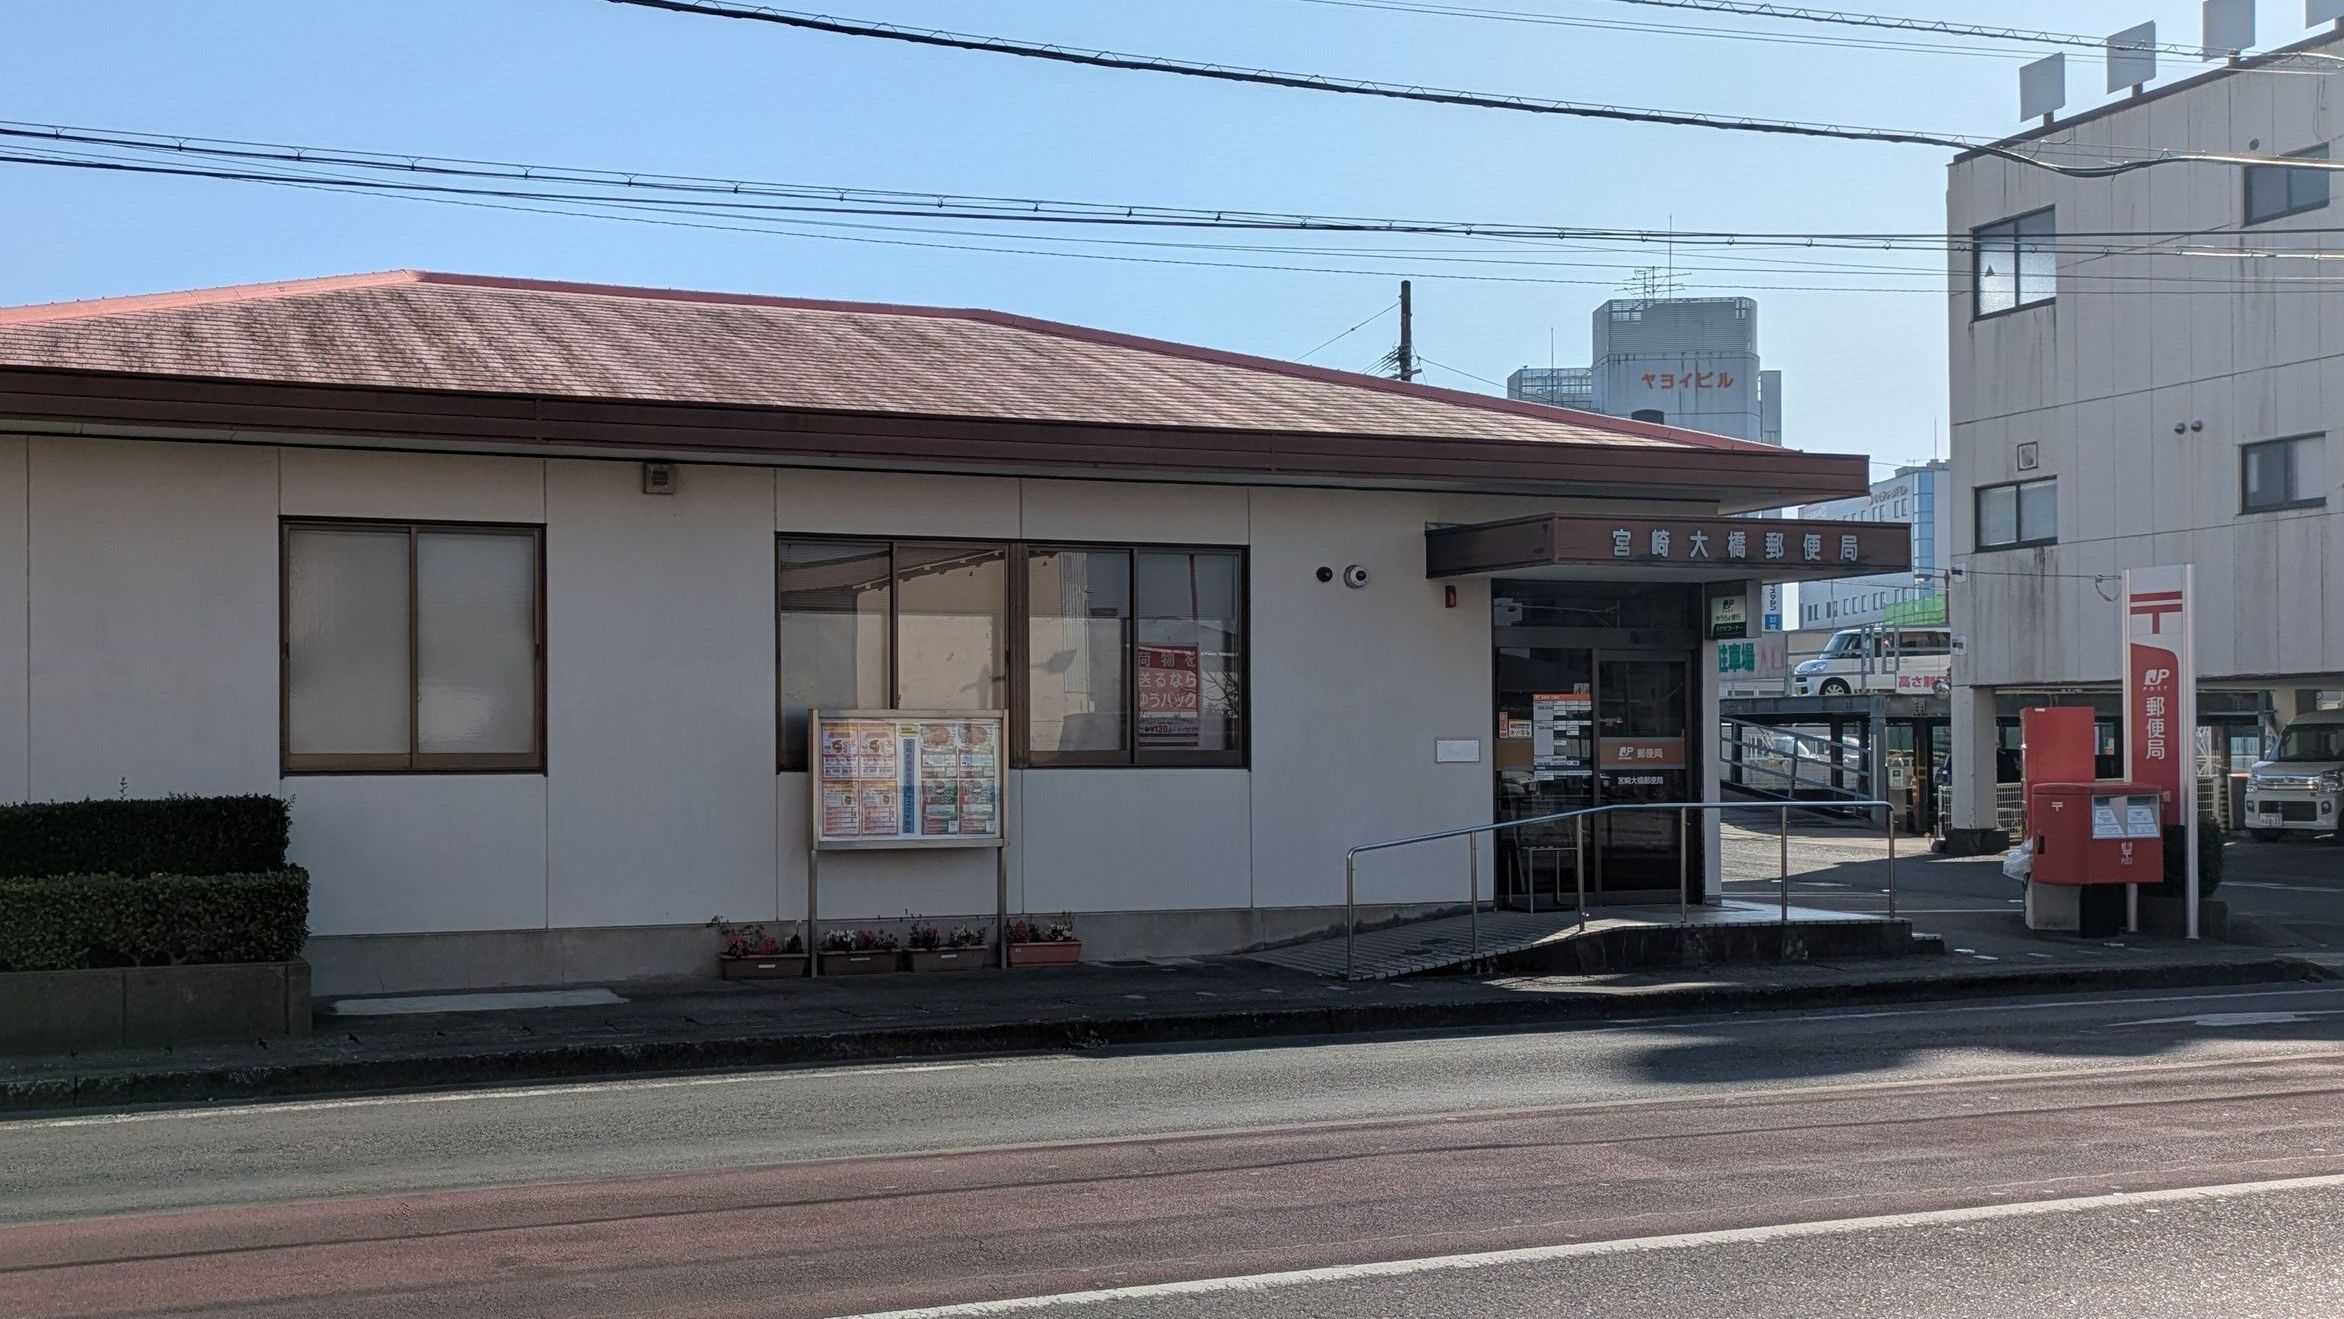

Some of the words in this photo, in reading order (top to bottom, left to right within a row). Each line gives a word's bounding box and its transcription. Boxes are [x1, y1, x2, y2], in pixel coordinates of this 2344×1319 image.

[1641, 371, 1734, 389] ヤヨイビル
[1612, 528, 1858, 562] 宮崎大橋郵便局
[1138, 671, 1197, 688] 送るなら
[1898, 675, 1948, 688] 高さ制
[1138, 691, 1197, 709] ゆうパック
[2145, 696, 2166, 760] 郵便局
[1637, 747, 1663, 759] 郵便局
